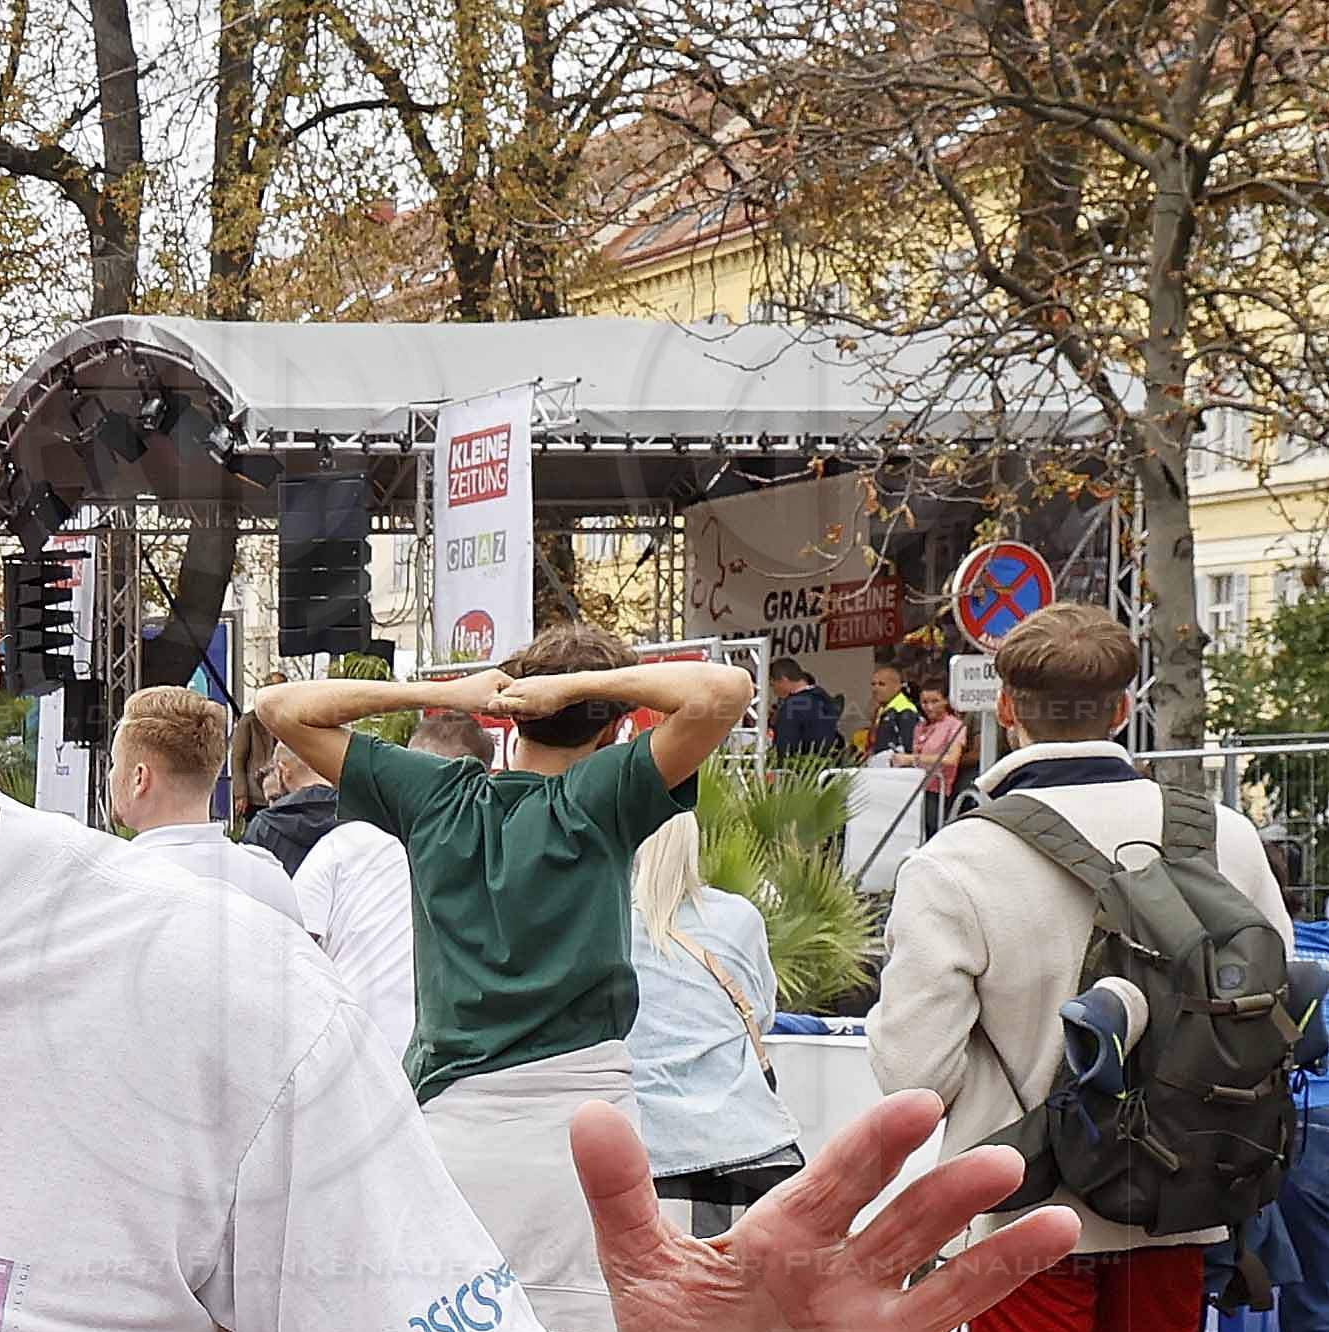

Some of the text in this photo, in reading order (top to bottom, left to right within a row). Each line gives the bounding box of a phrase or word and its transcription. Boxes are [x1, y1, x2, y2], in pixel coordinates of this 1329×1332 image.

[451, 432, 509, 469] KLEINE
[449, 462, 507, 500] ZEITUNG
[446, 531, 506, 571] GRAZ
[764, 586, 826, 622] GRAZ
[828, 614, 895, 643] ZEITUNG
